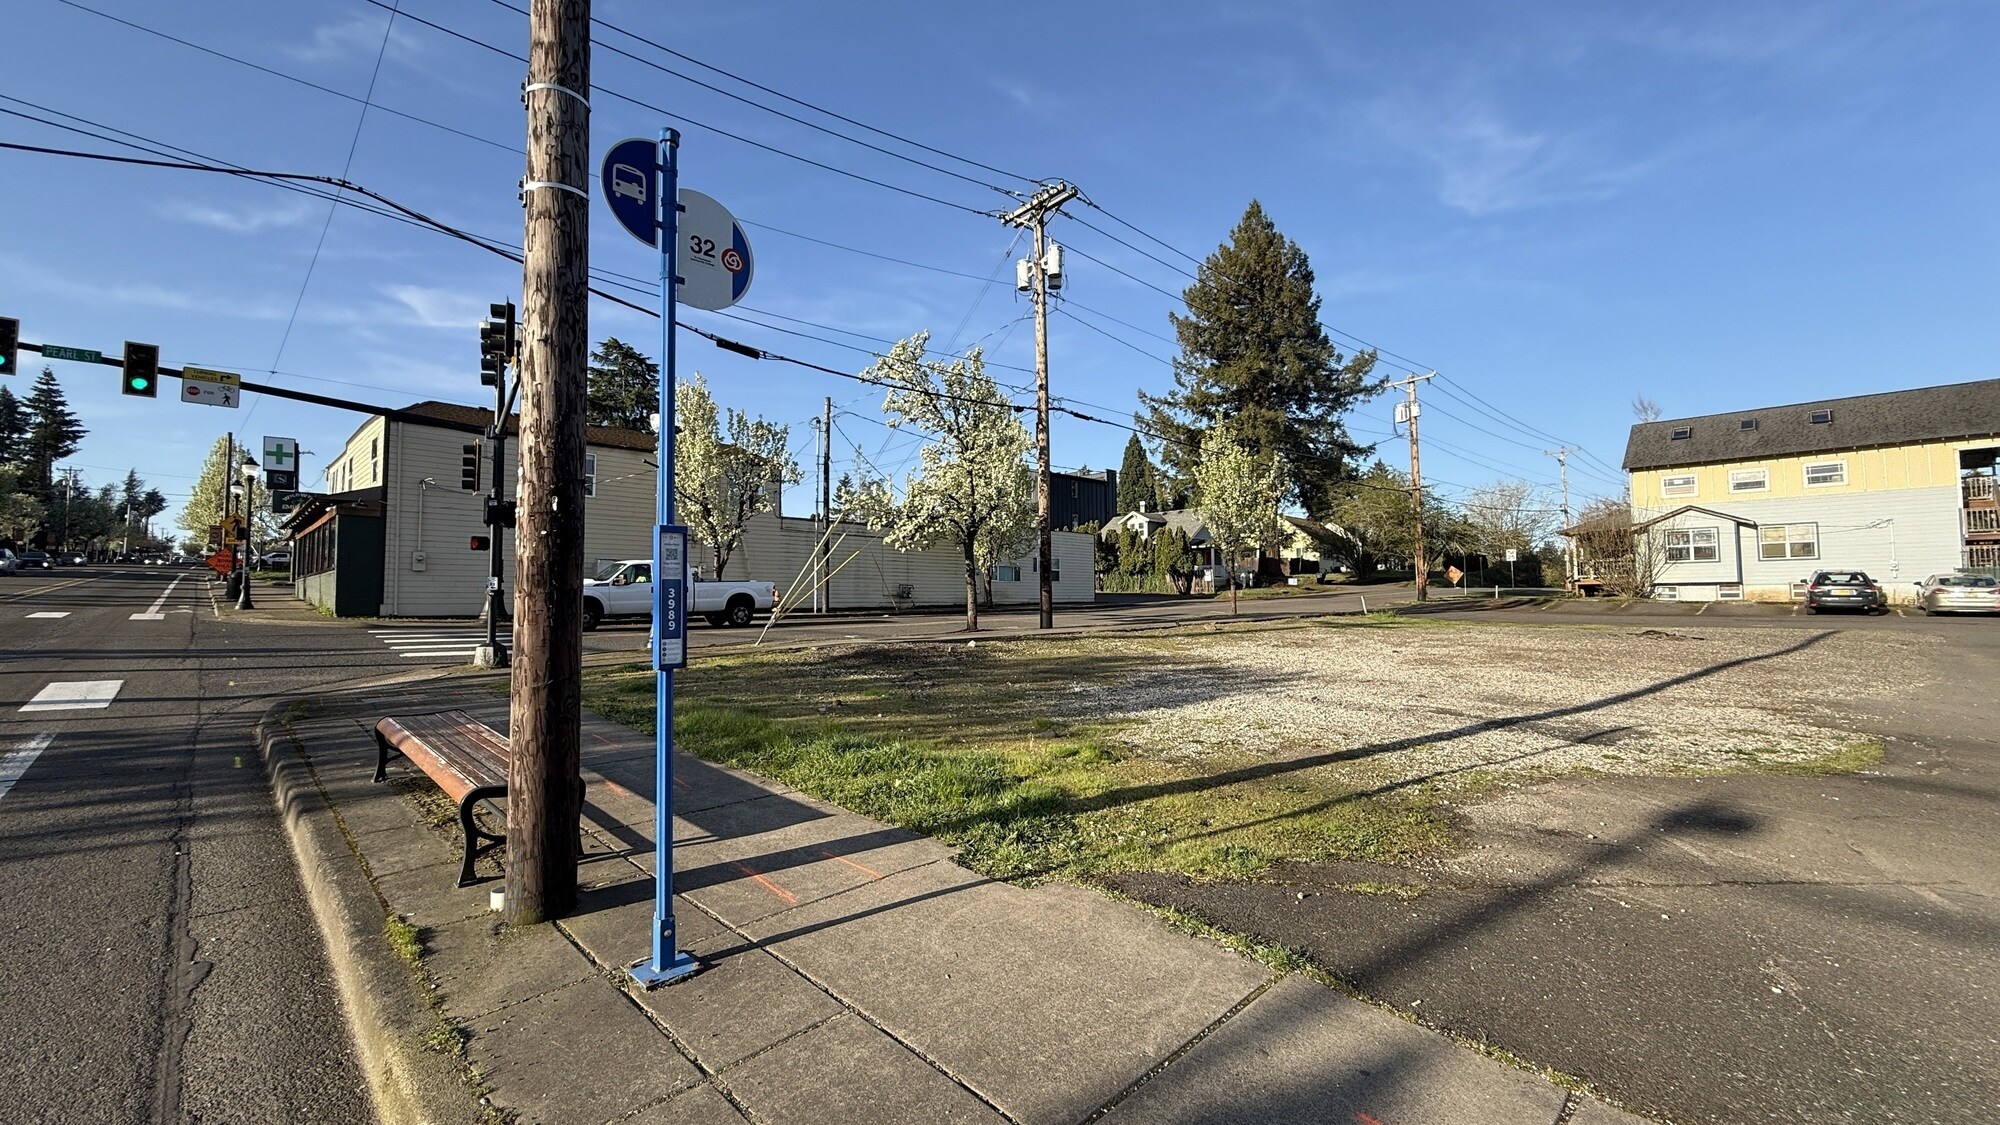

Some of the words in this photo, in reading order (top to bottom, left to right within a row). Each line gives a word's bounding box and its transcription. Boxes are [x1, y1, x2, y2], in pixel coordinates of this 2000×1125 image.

[690, 235, 715, 258] 32
[46, 346, 79, 360] PEARL
[84, 352, 97, 361] ST
